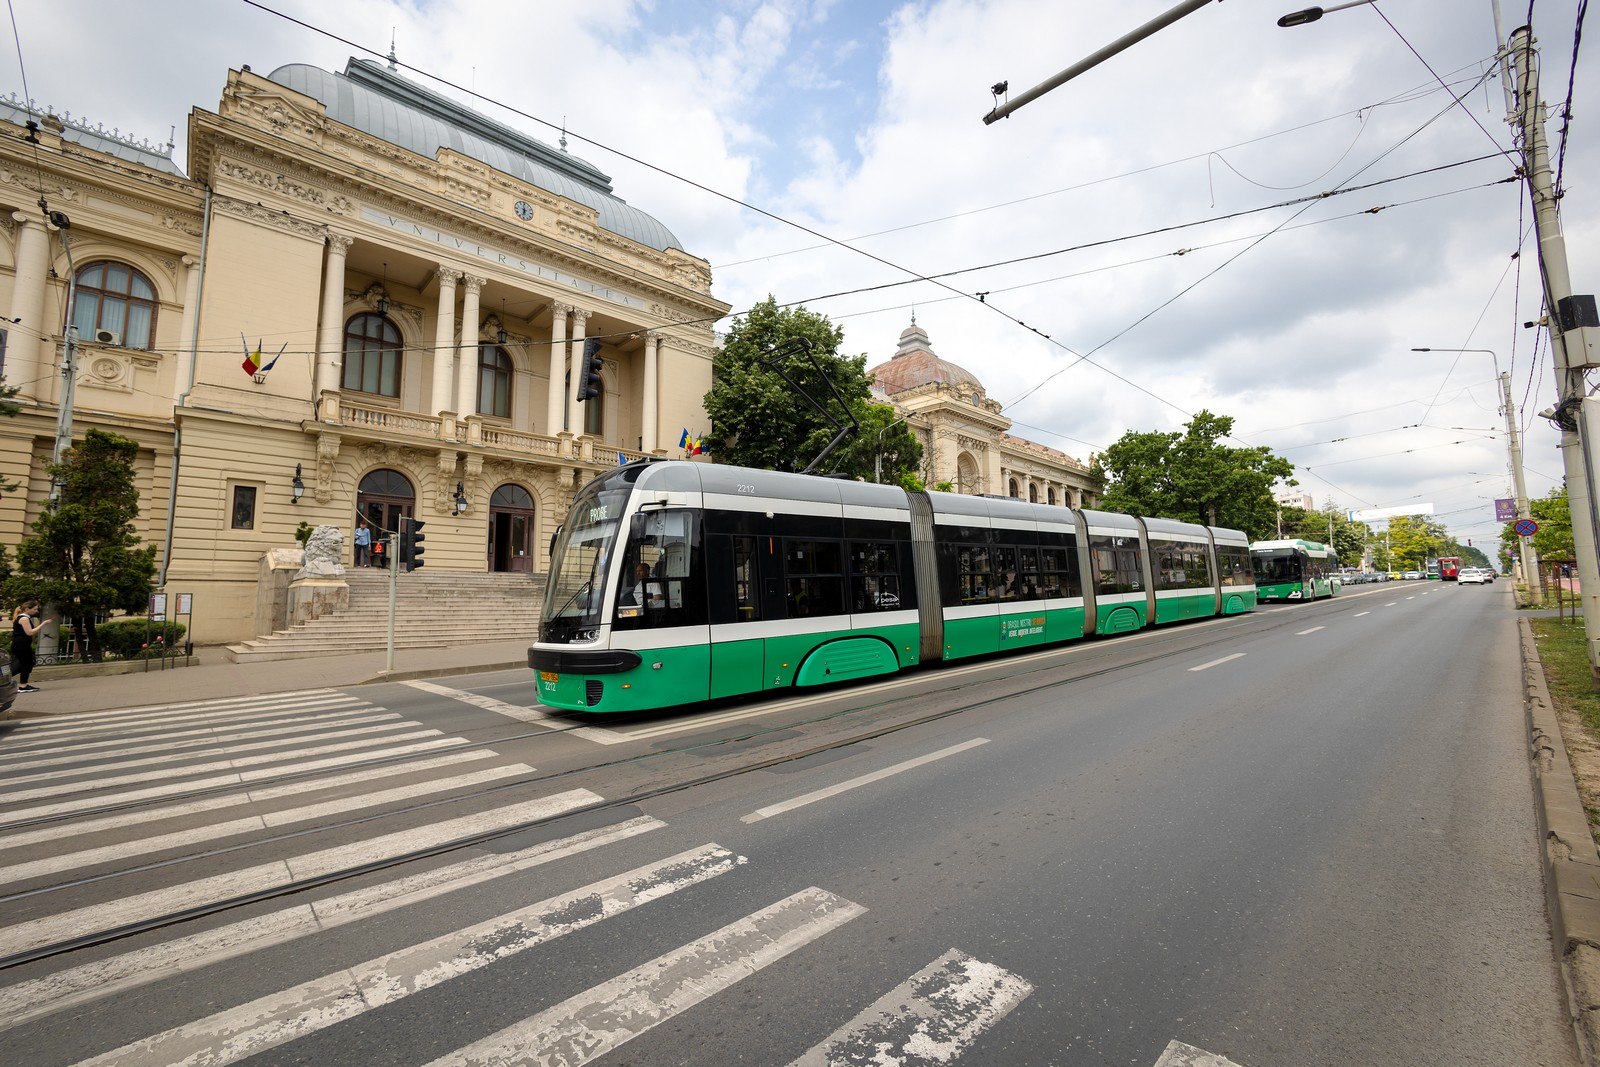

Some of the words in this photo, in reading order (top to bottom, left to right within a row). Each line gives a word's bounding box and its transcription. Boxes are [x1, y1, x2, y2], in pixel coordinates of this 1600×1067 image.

[388, 216, 630, 305] VNIVERSITATEA
[737, 484, 755, 494] 2212
[590, 505, 608, 522] PROBE
[544, 681, 556, 692] 2212
